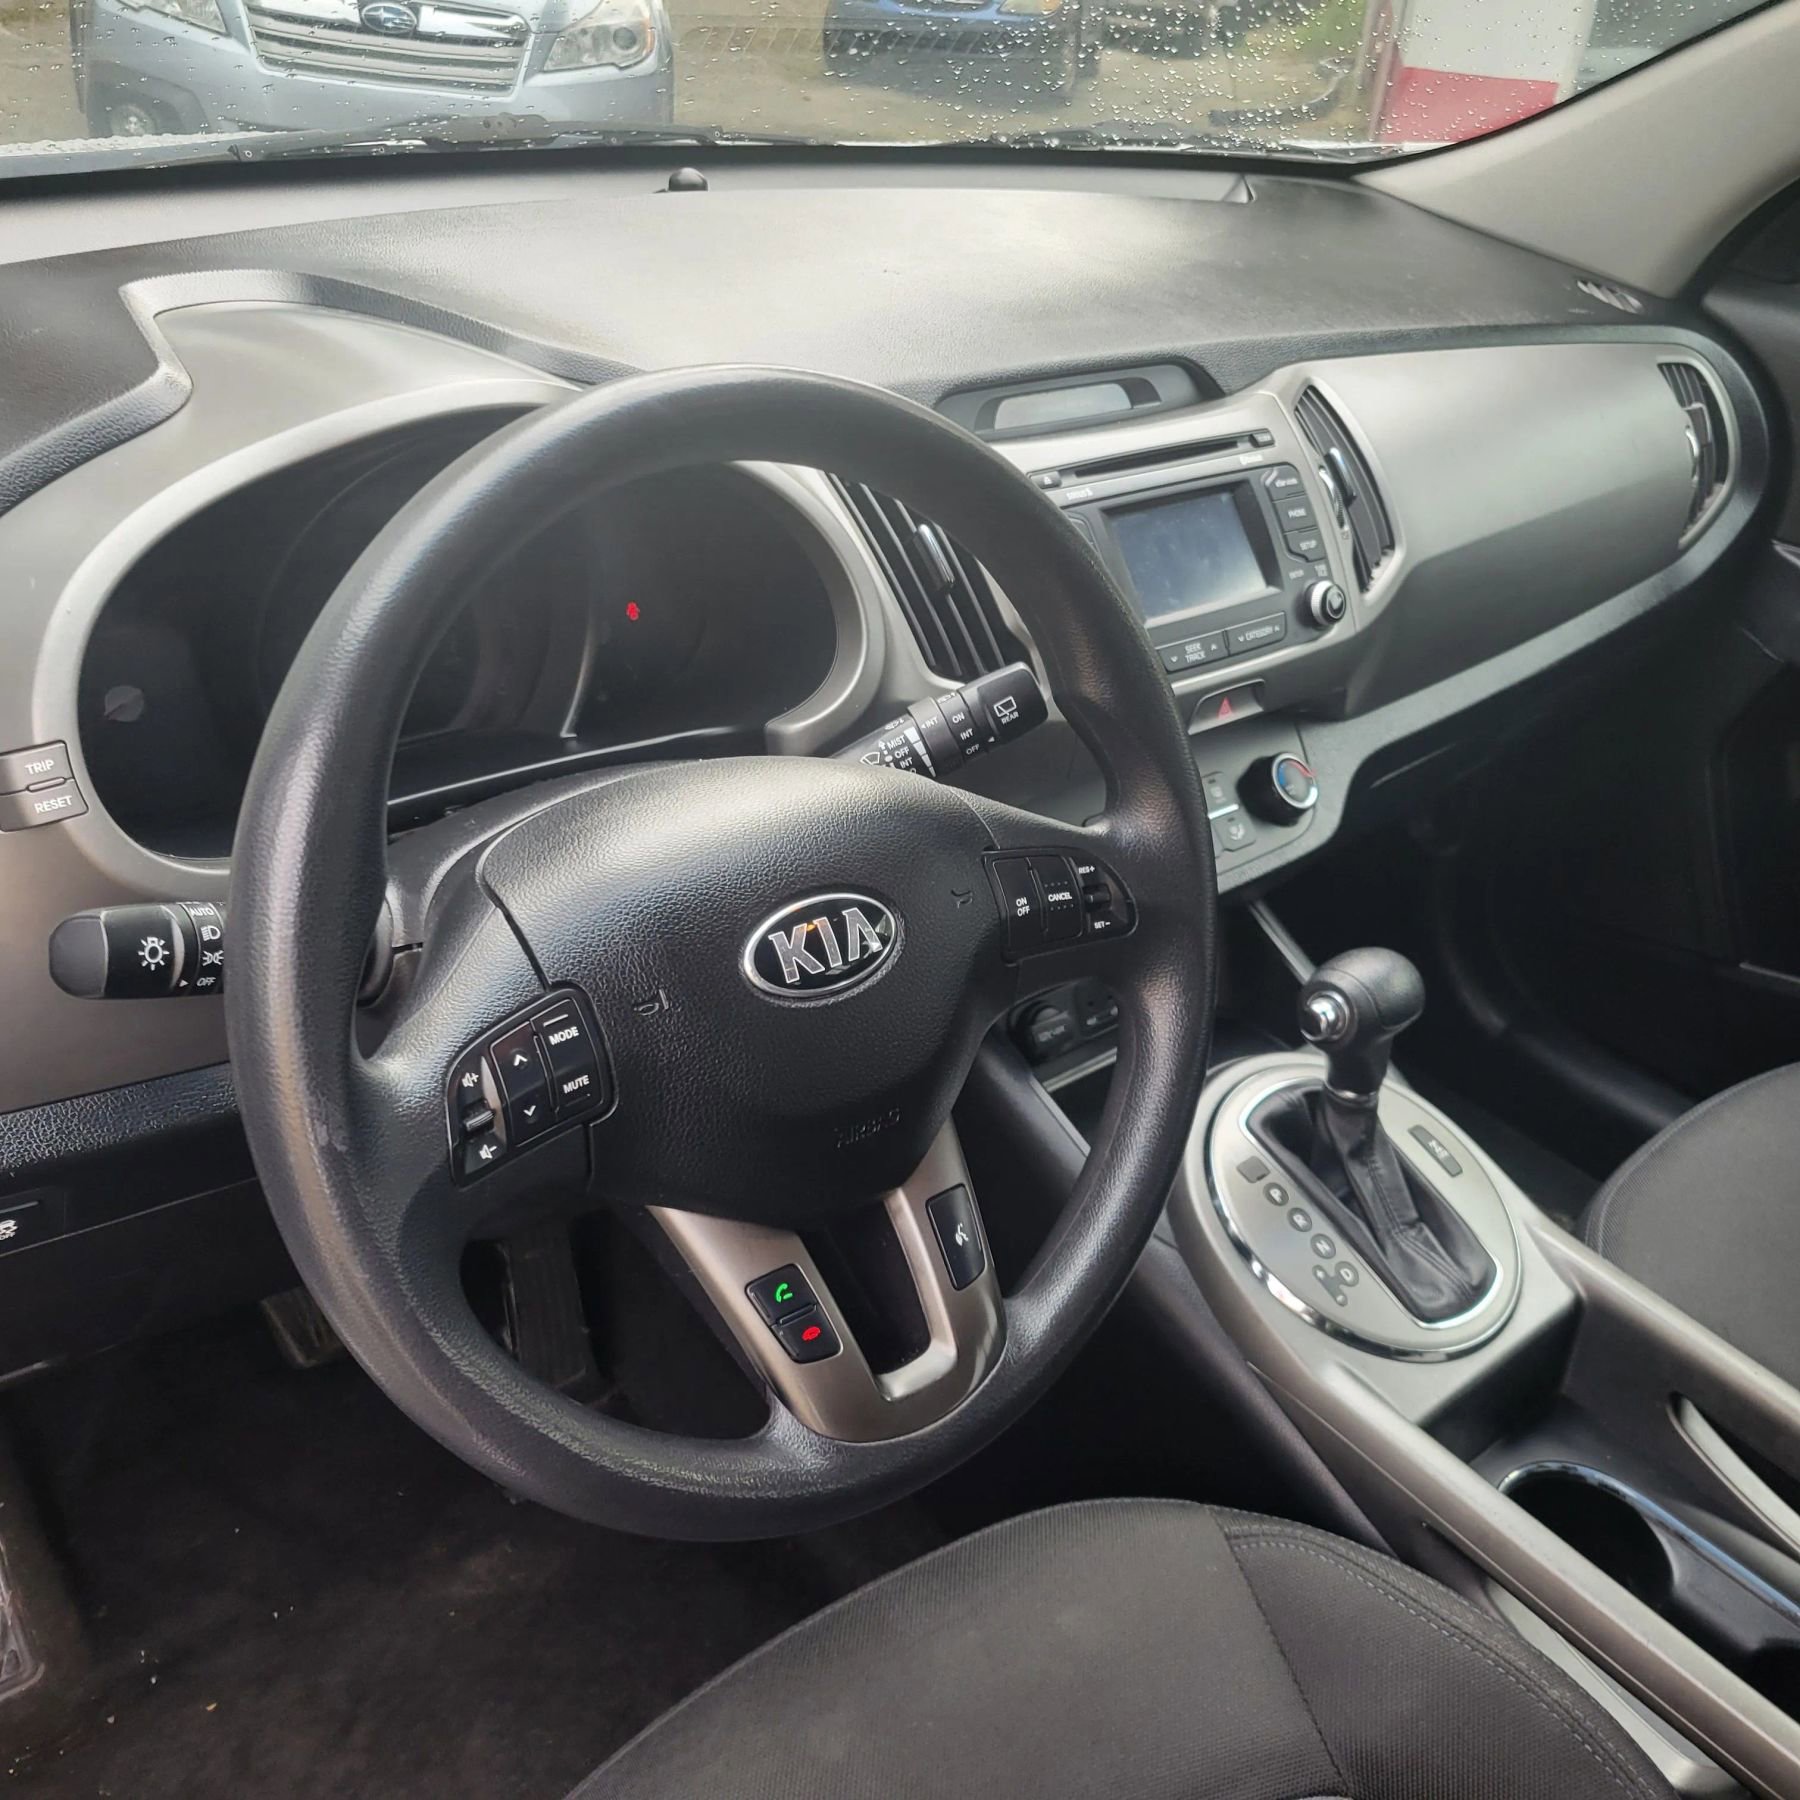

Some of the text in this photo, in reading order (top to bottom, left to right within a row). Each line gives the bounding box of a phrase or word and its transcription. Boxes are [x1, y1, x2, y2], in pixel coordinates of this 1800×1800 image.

[1185, 643, 1202, 654] SEEK
[925, 716, 938, 729] INT
[952, 712, 965, 724] ON
[1001, 711, 1019, 725] REAR
[960, 728, 973, 741] INT
[886, 735, 906, 751] MIST
[966, 743, 980, 755] OFF
[894, 746, 910, 759] OFF
[25, 759, 55, 775] TRIP
[899, 757, 913, 769] INT
[34, 795, 73, 814] RESET
[1015, 897, 1028, 907] ON
[1048, 891, 1073, 902] CANCEL
[190, 907, 215, 916] AUTO
[1017, 906, 1031, 917] OFF
[767, 907, 883, 984] KIA
[196, 976, 216, 986] OFF
[549, 1026, 579, 1046] MODE
[563, 1074, 590, 1094] MUTE
[1270, 1188, 1282, 1203] P
